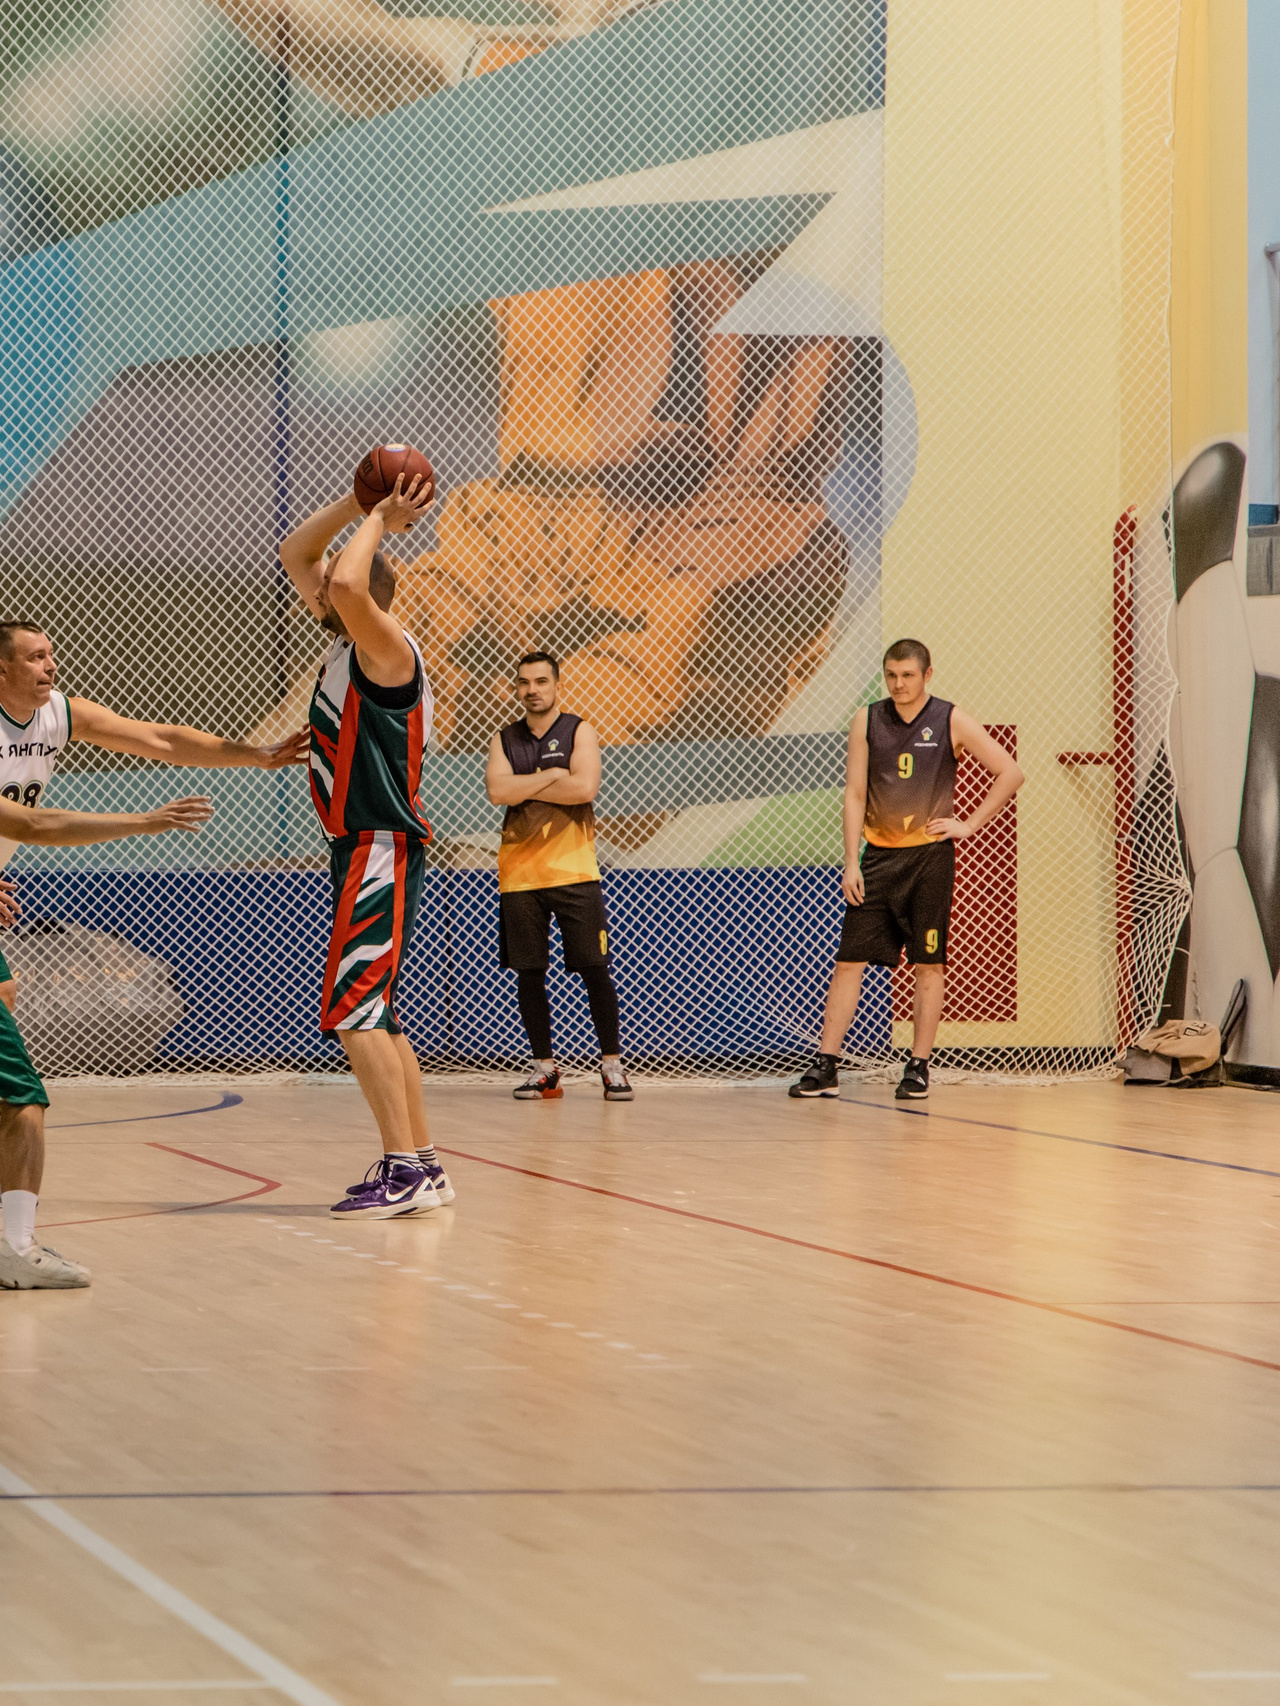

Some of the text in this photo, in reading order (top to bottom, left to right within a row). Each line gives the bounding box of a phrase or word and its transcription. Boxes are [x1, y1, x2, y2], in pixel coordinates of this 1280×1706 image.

[8, 742, 58, 761] ЯНГПУ
[898, 752, 914, 779] 9
[925, 928, 939, 954] 9
